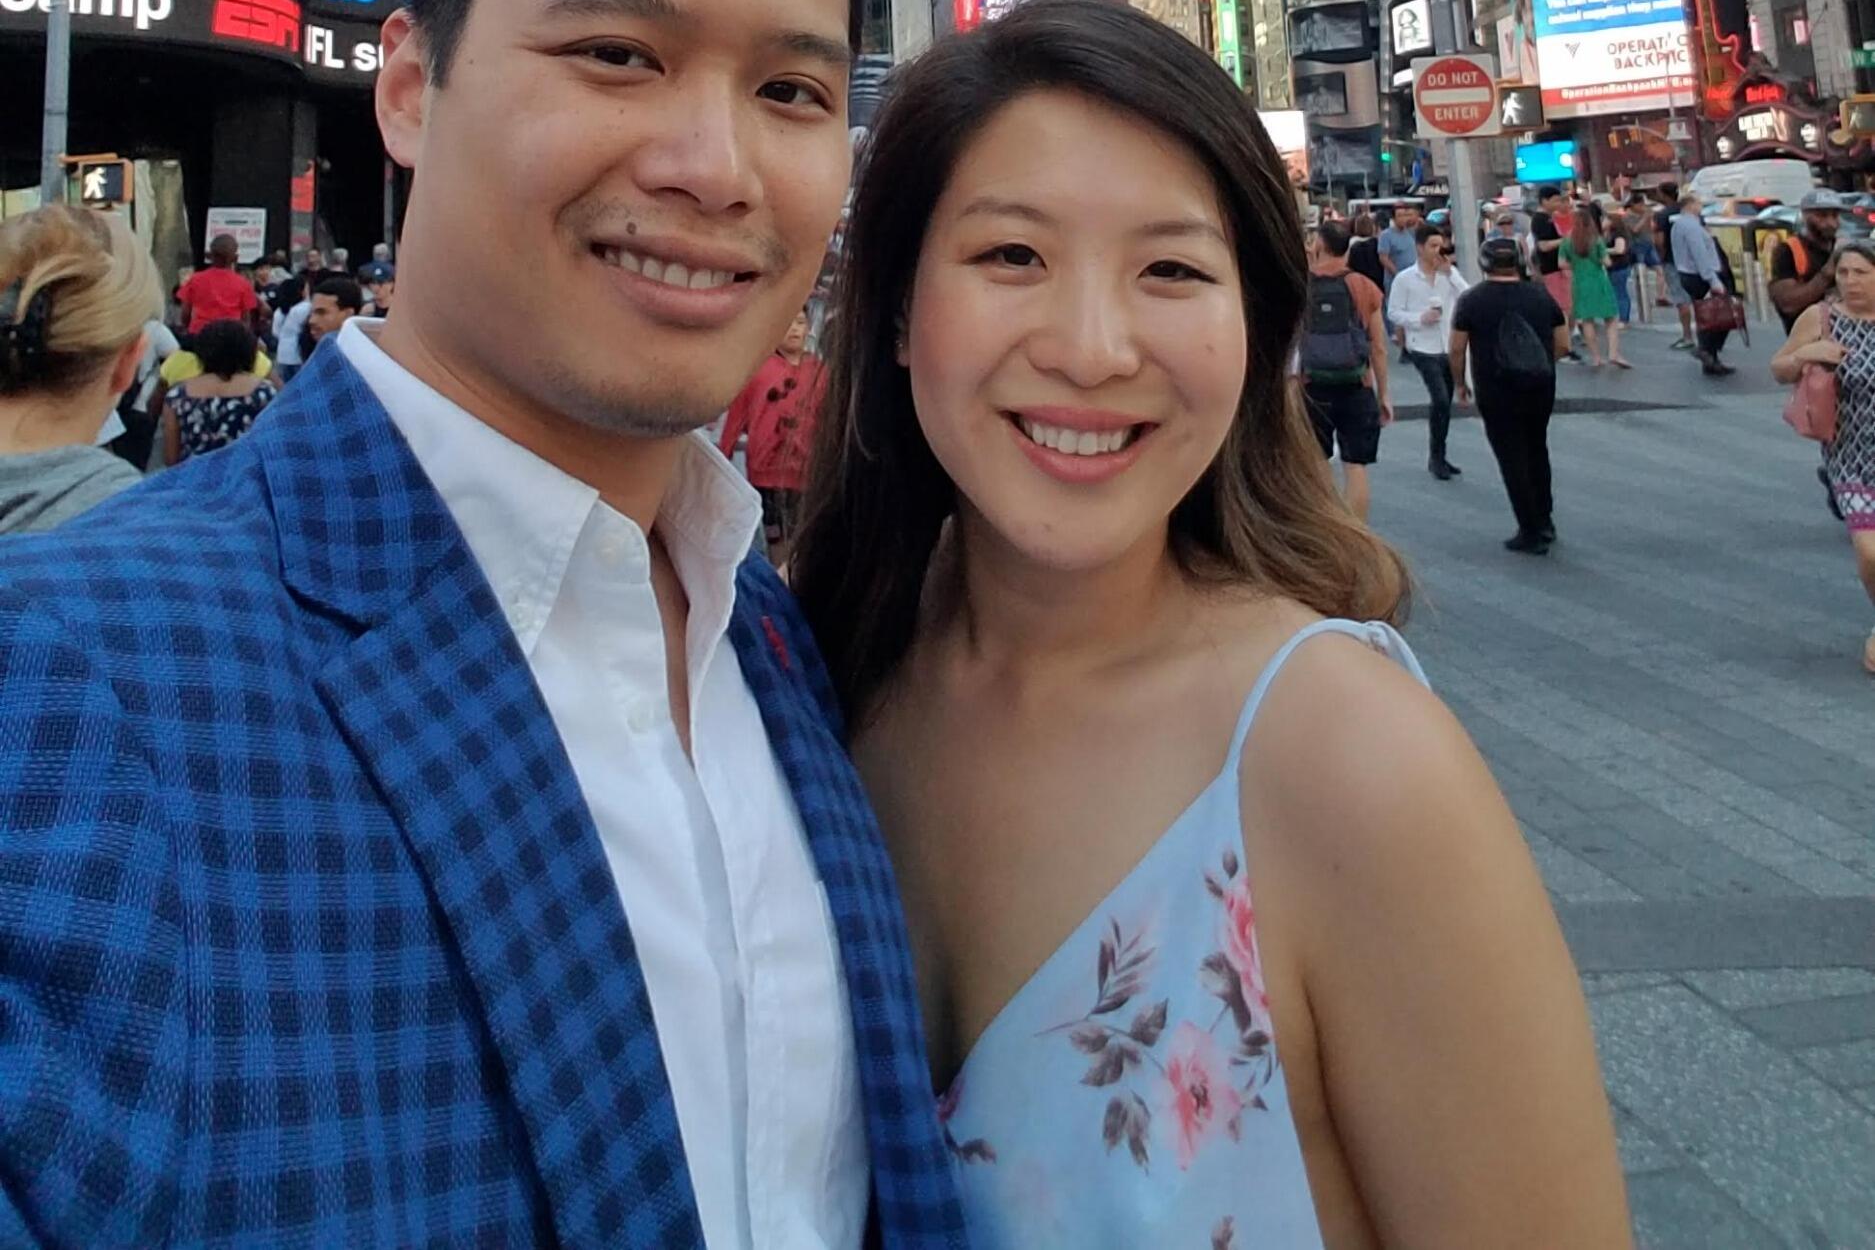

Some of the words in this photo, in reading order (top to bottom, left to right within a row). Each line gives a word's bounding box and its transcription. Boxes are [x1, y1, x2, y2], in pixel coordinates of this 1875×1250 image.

[306, 24, 345, 69] FL
[1614, 50, 1687, 70] BACKPAC
[1427, 73, 1448, 87] DO
[1452, 71, 1479, 85] NOT
[1435, 106, 1479, 122] ENTER
